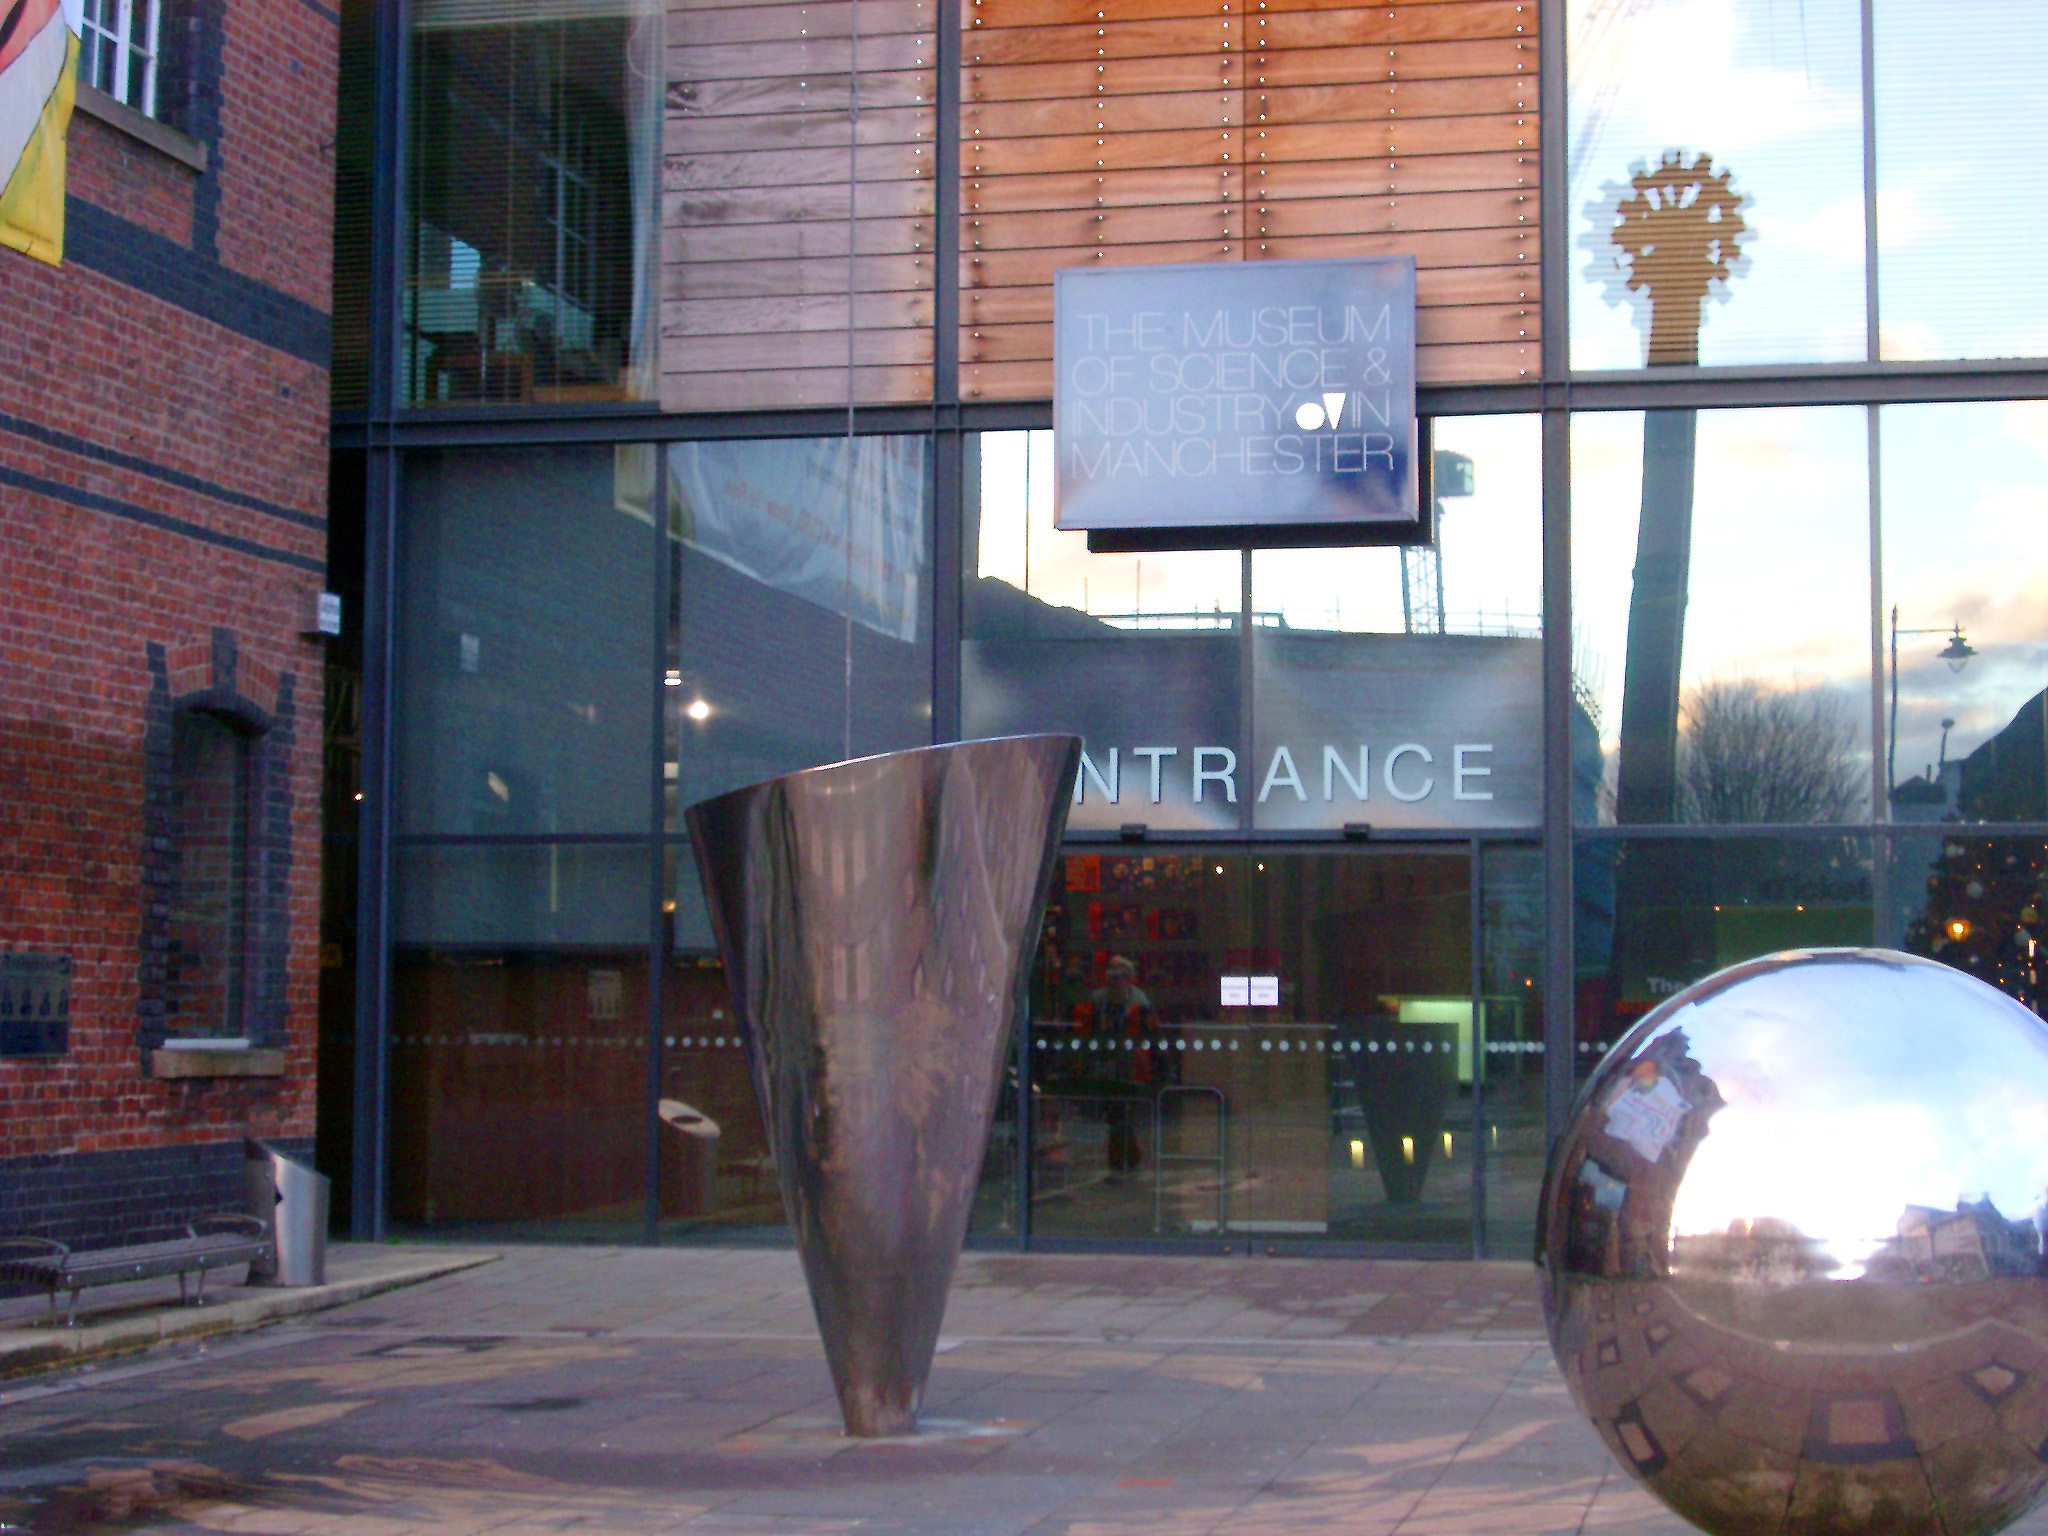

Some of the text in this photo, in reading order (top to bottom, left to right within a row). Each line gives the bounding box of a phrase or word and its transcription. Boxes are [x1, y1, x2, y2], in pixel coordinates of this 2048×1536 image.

[1078, 303, 1391, 352] THE MUSEUM
[1071, 346, 1394, 396] OF SCIENCE &
[1072, 390, 1391, 437] INDUSTRY IN
[1071, 432, 1395, 479] MANCHESTER
[1074, 743, 1494, 805] NTRANCE
